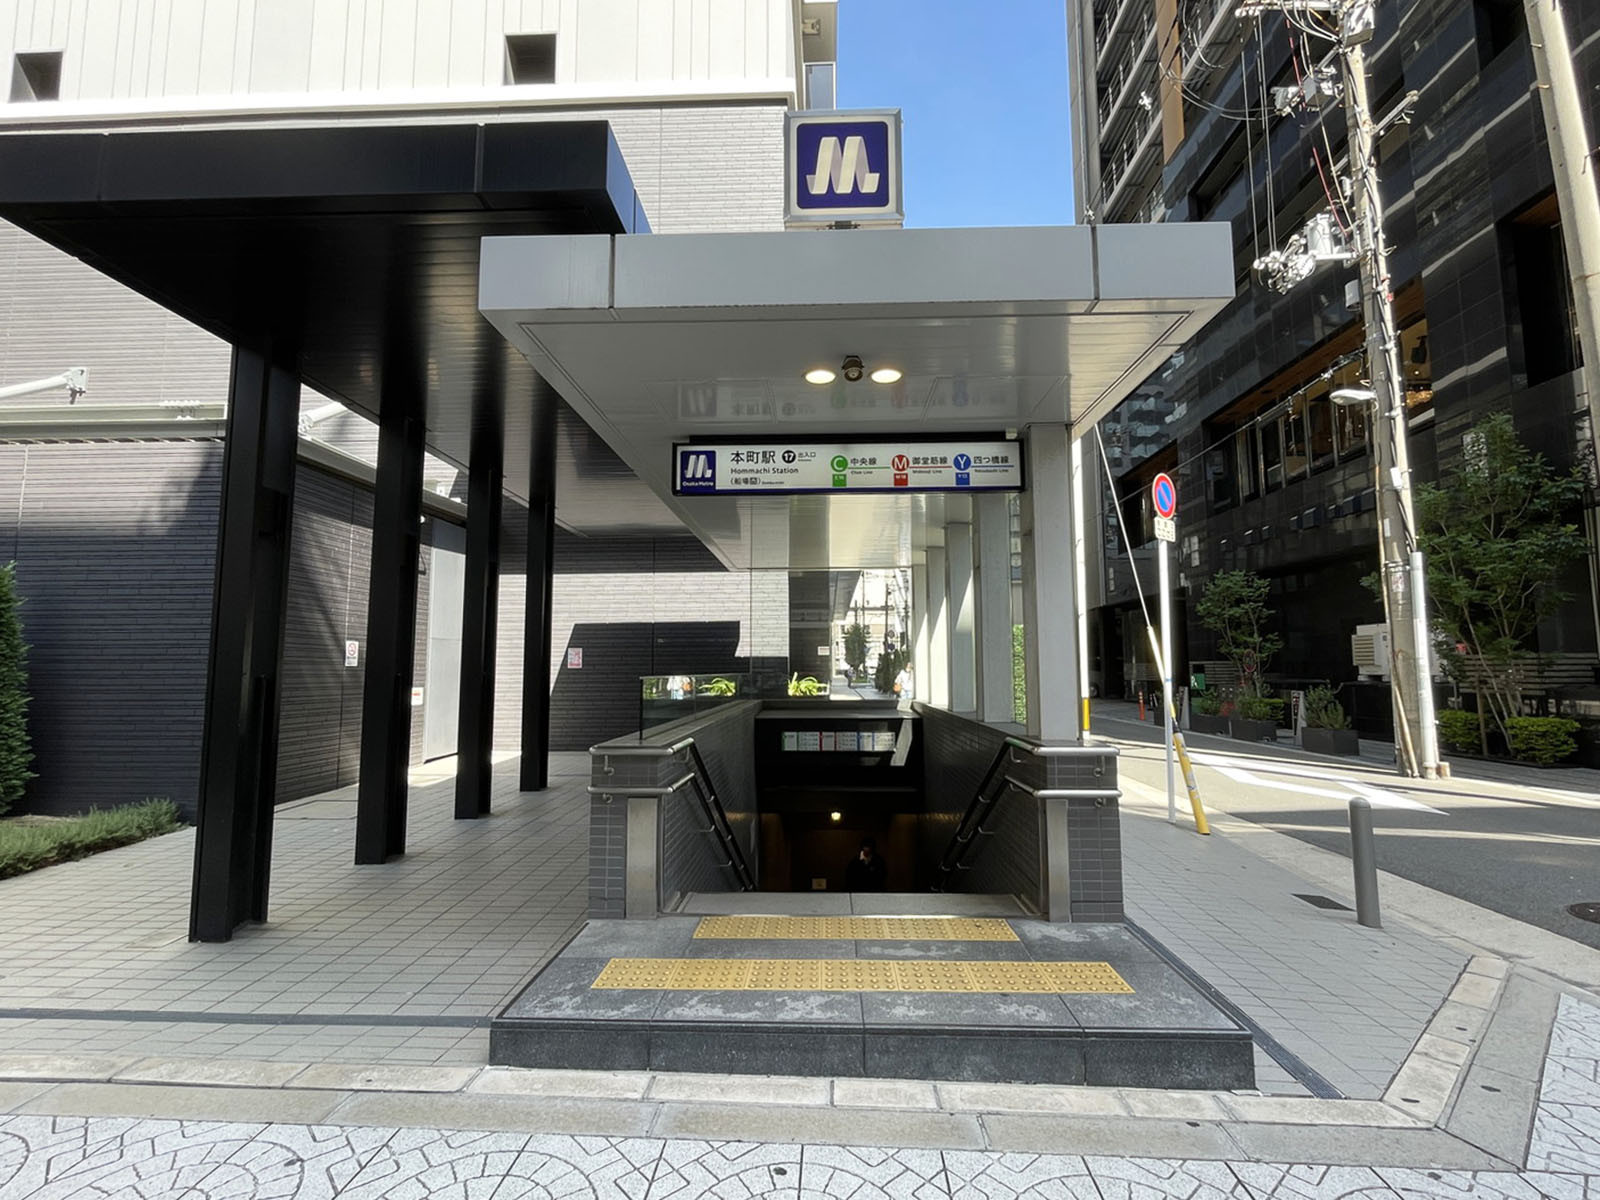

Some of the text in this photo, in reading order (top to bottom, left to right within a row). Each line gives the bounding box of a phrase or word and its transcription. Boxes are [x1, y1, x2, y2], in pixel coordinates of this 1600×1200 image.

[730, 450, 776, 464] 本町駅
[783, 451, 795, 463] 17
[832, 456, 845, 470] C
[850, 457, 877, 466] 中央線
[894, 456, 908, 470] M
[956, 455, 968, 469] Y
[730, 466, 799, 474] Hommachi Station
